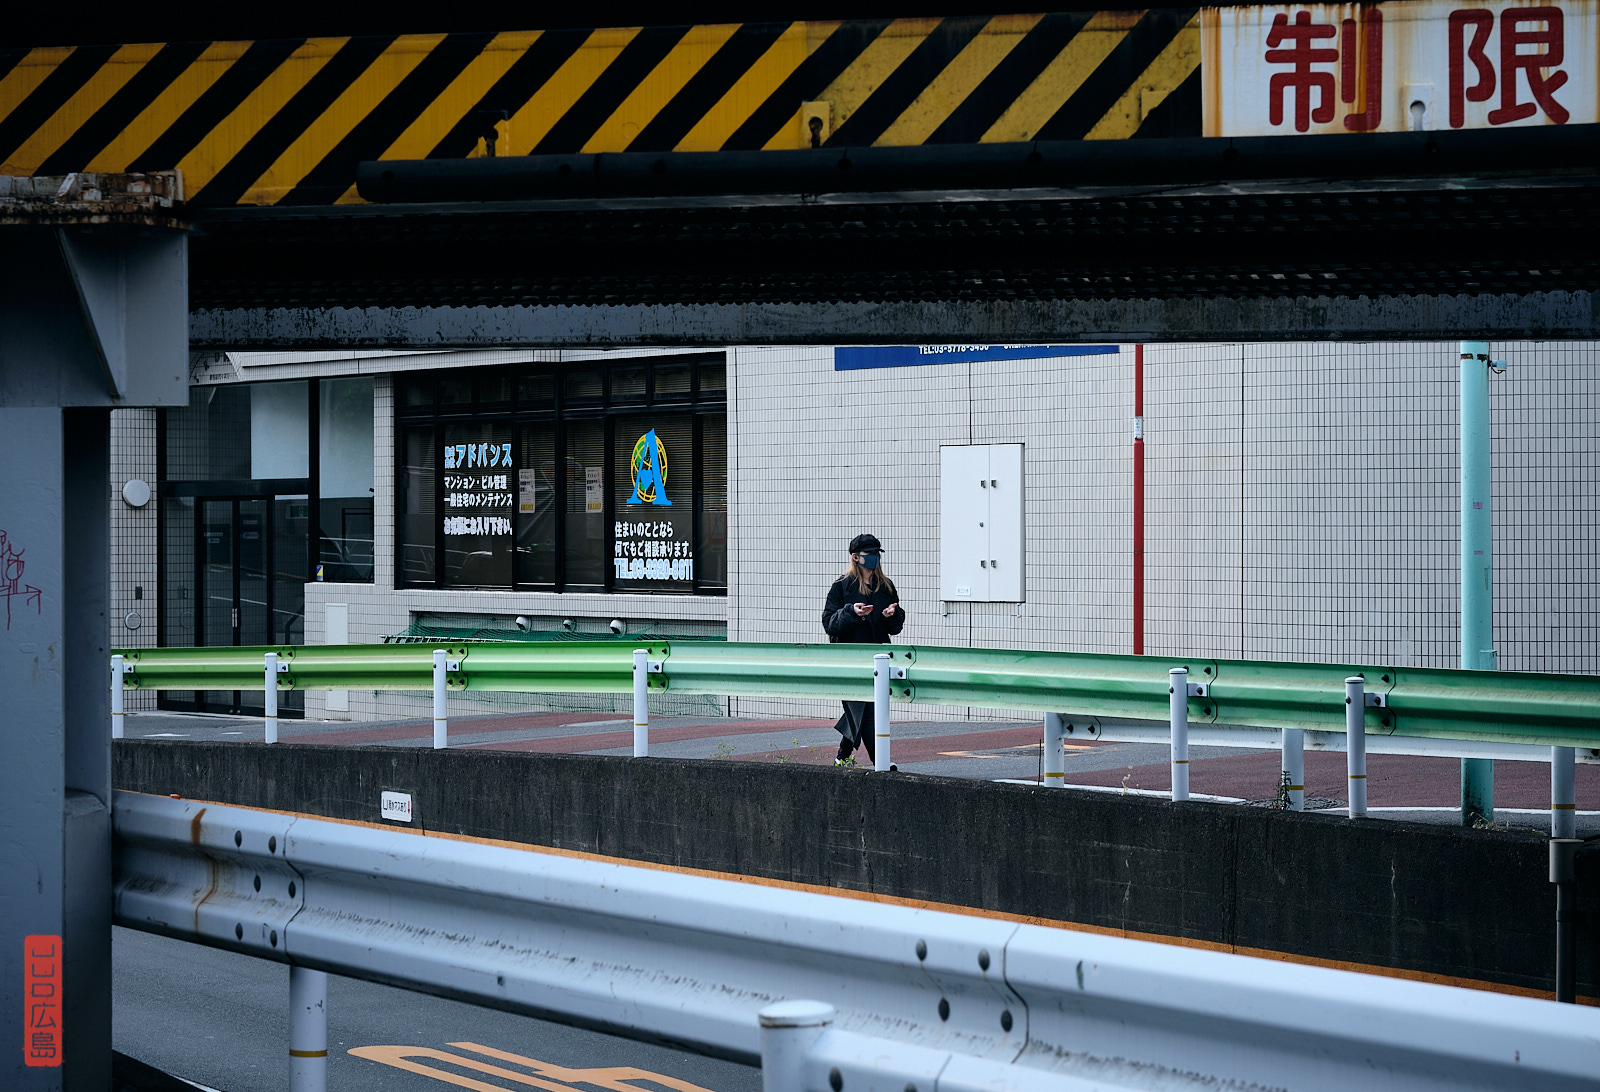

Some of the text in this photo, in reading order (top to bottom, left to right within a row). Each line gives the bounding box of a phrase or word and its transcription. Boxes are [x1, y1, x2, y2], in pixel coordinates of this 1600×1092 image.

[1265, 6, 1570, 132] 制限
[444, 492, 513, 508] 一般住宅のメンテナンス
[614, 521, 674, 538] 住まいのことなら
[614, 540, 693, 558] 何でもご相談承ります。
